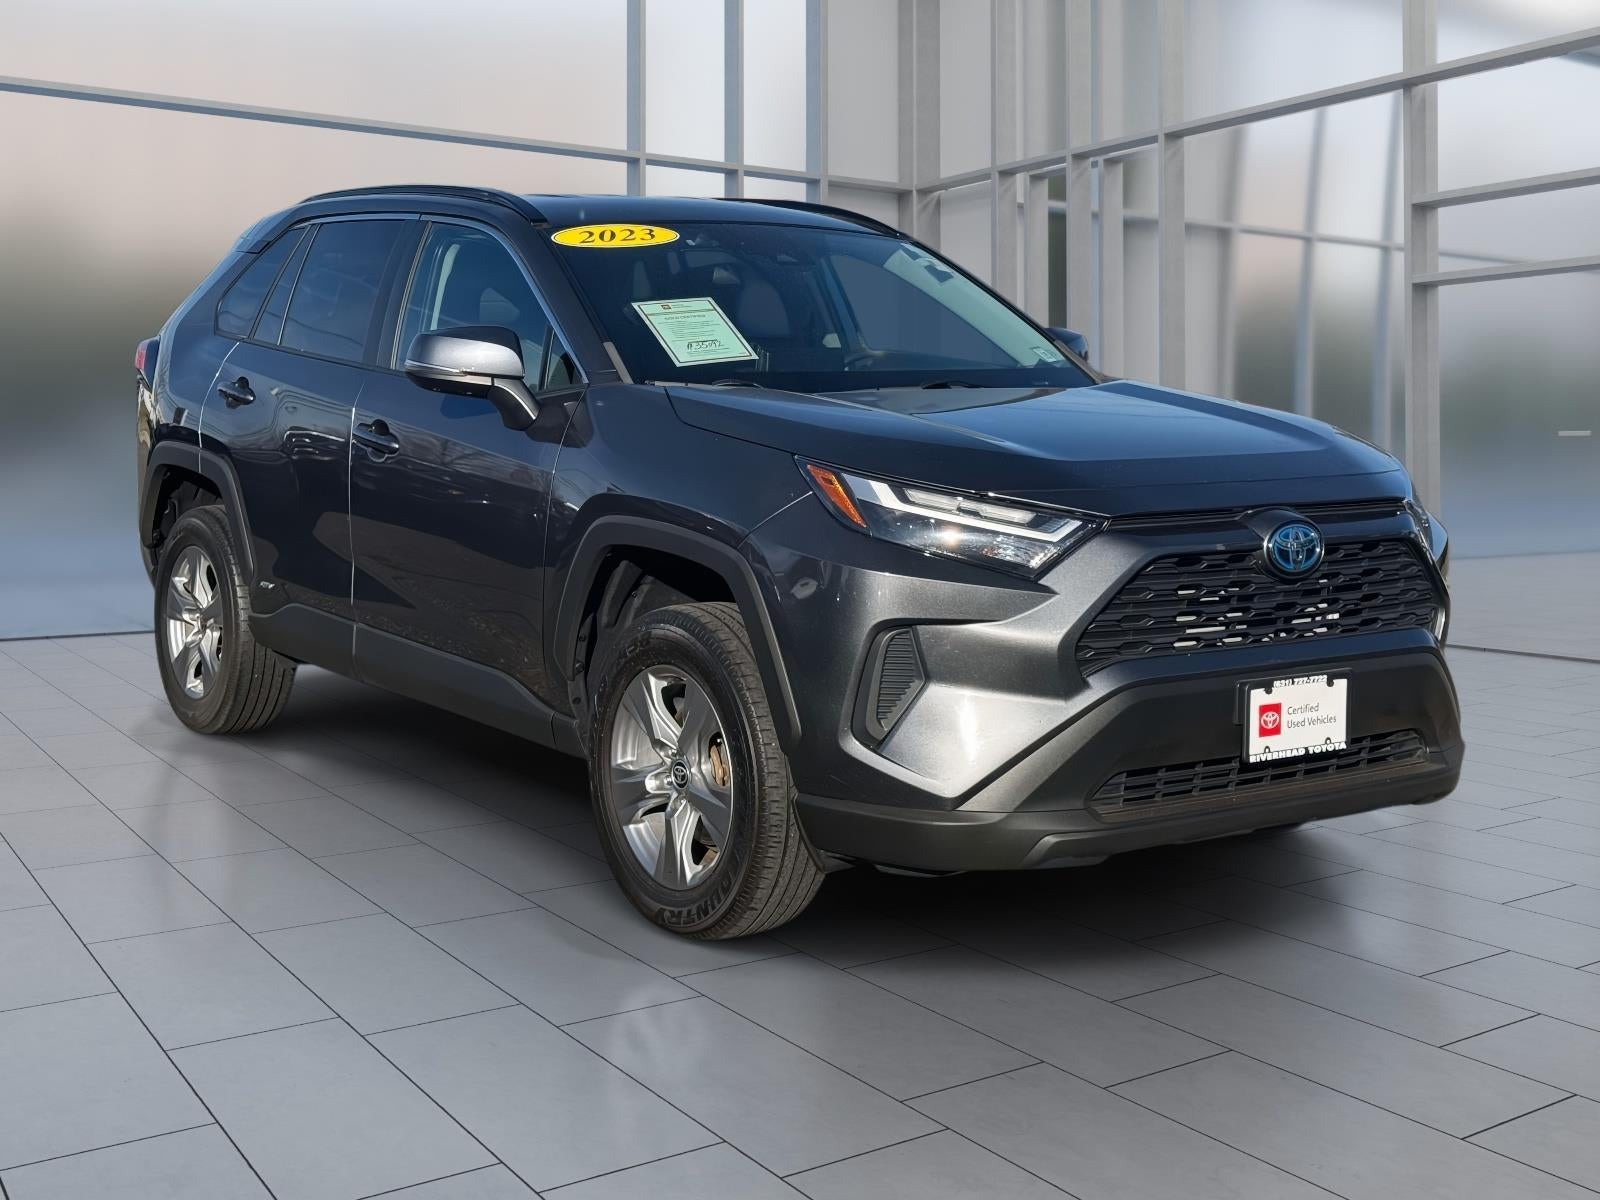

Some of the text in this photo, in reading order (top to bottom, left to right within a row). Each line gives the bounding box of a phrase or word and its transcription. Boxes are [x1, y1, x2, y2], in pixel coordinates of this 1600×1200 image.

[578, 228, 656, 244] 2023
[1287, 702, 1319, 714] Certified
[1287, 714, 1336, 728] Used Vehicles
[1250, 742, 1347, 763] RIVERHEAD TOYOTA
